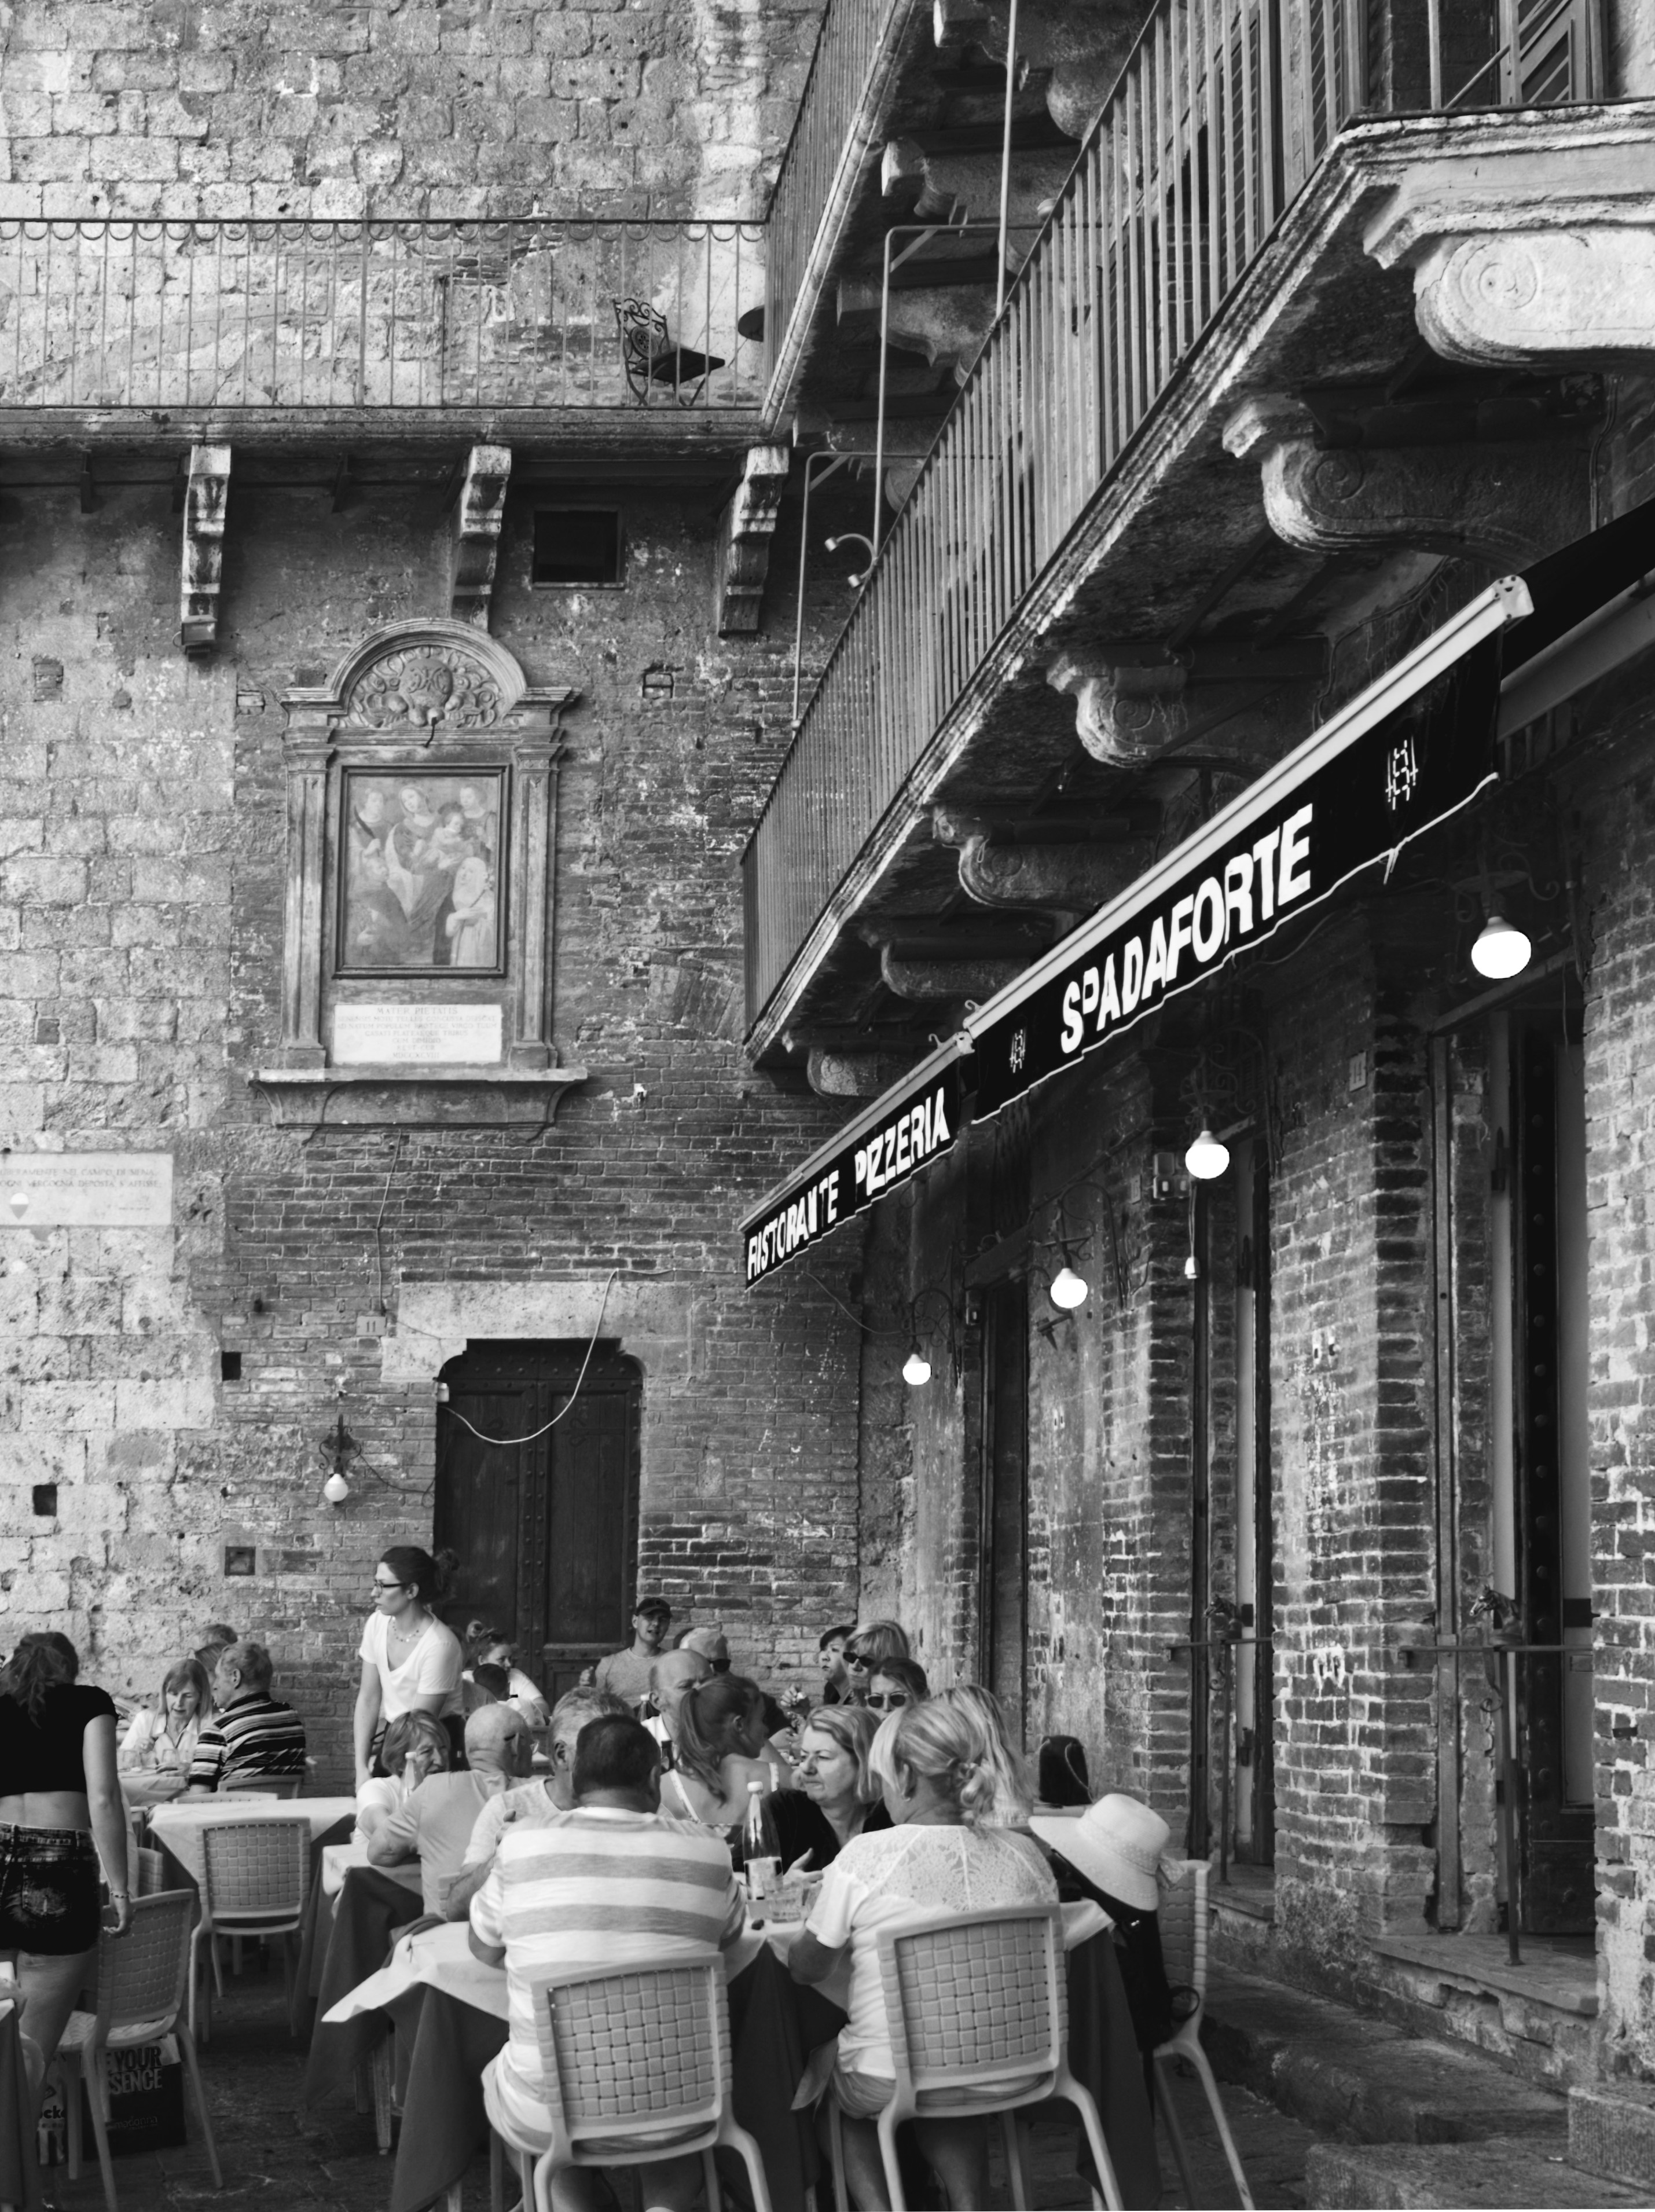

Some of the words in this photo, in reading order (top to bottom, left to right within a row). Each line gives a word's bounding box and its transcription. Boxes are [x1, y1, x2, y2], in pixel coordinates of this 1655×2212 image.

[1060, 803, 1313, 1053] SPADAFORTE
[854, 1087, 951, 1196] PIZZERIA
[366, 1320, 376, 1333] 11
[114, 2046, 162, 2071] YOUR
[108, 2068, 163, 2095] SENCE
